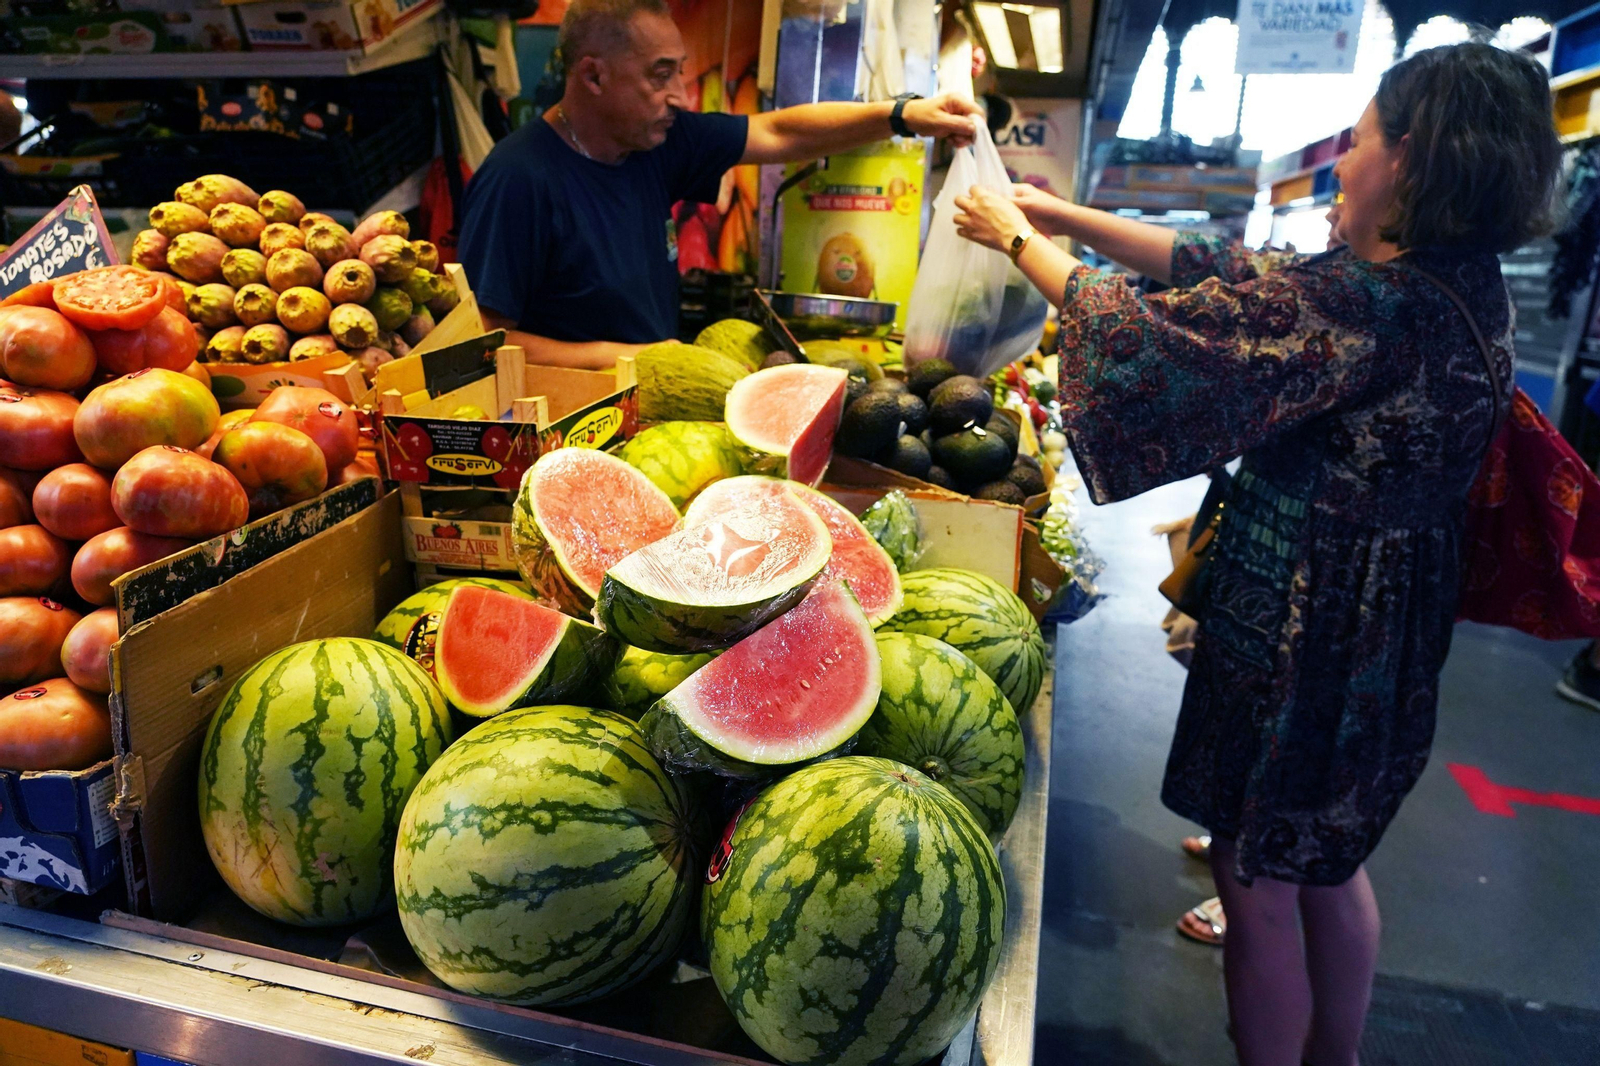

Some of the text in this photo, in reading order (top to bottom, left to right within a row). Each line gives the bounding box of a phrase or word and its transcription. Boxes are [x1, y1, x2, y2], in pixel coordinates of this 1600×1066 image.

[1259, 15, 1343, 32] VARIEDAD
[855, 198, 887, 210] MUEVE
[0, 222, 69, 286] TOMATES
[29, 221, 98, 284] ROSADO
[415, 533, 462, 552] BUENOS
[465, 538, 499, 555] AIRES
